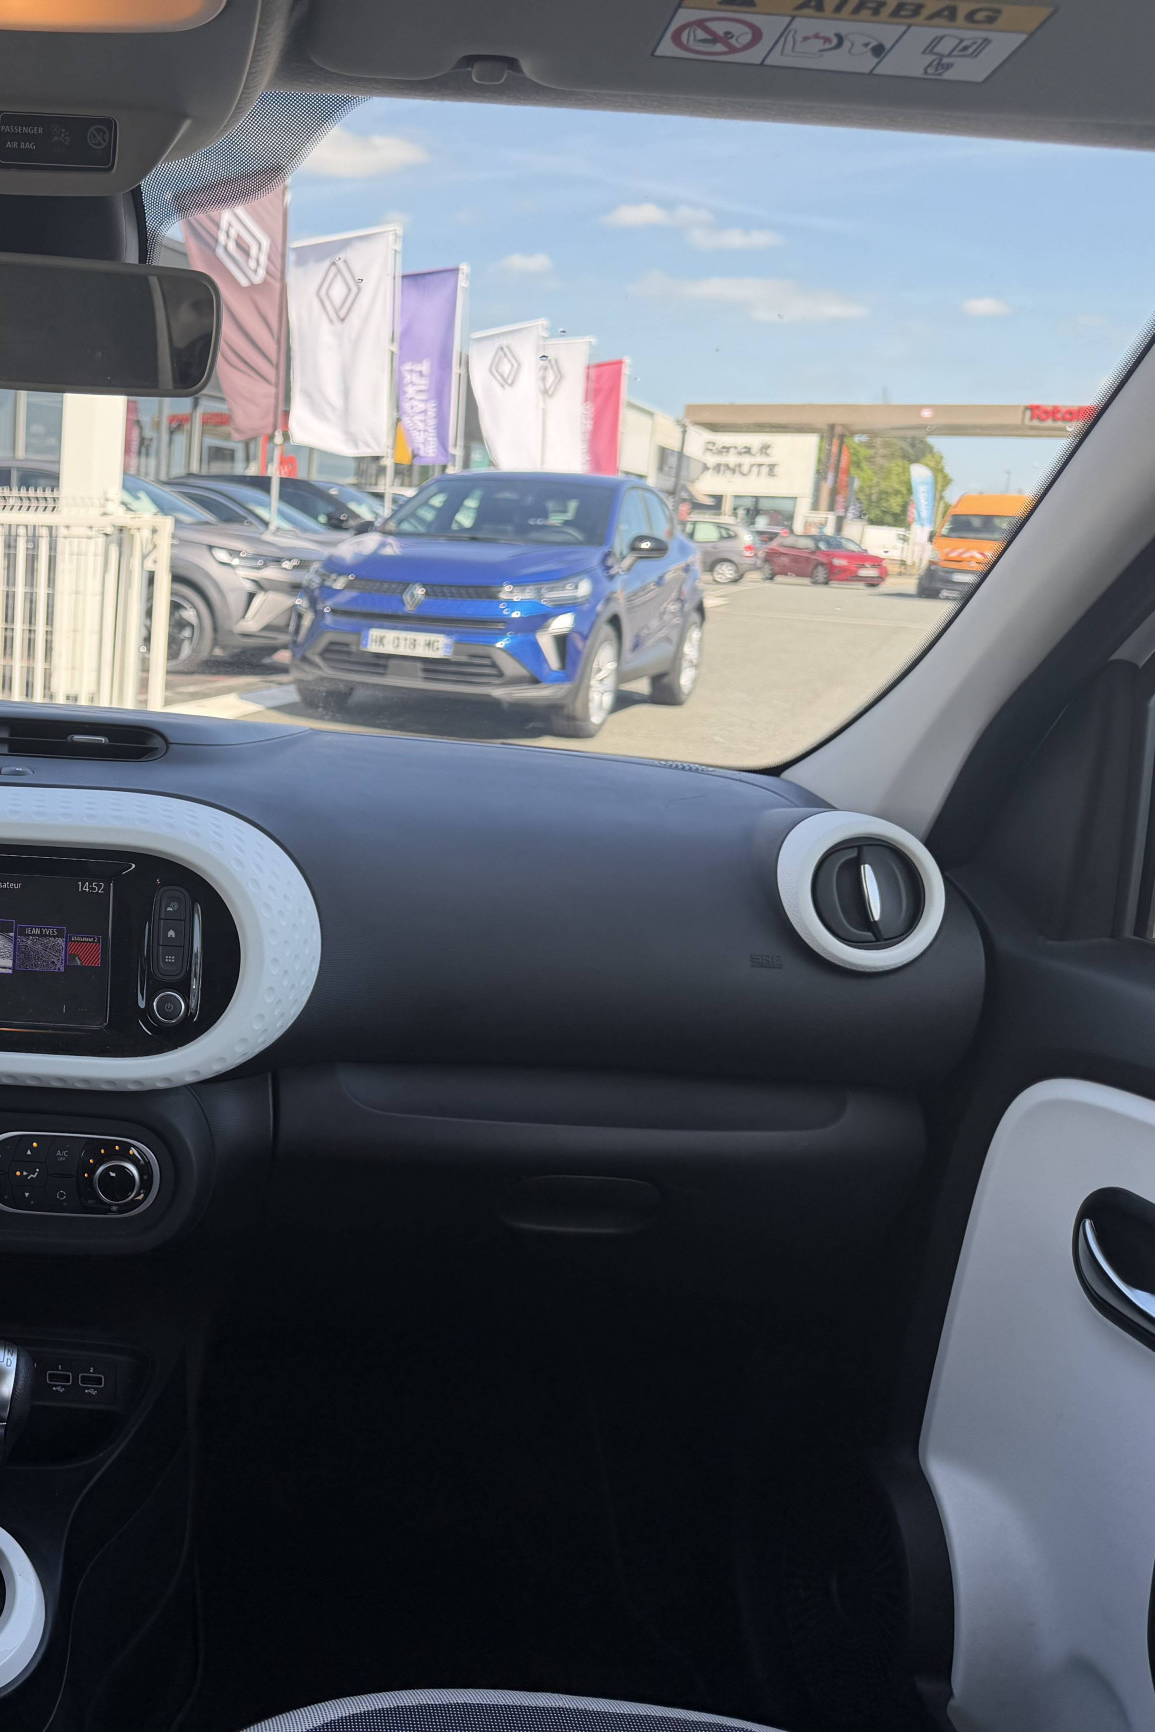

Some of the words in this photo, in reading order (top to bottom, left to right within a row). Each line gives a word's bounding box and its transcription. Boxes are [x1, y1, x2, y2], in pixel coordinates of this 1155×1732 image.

[793, 0, 1003, 25] AIRBAG
[1, 125, 44, 134] PASSENGER
[6, 141, 19, 149] AIR
[20, 141, 36, 150] BAG
[702, 441, 772, 457] Renault
[77, 881, 105, 893] 14:52
[26, 927, 41, 935] JEAN
[42, 928, 58, 936] YVES
[5, 1358, 13, 1367] D
